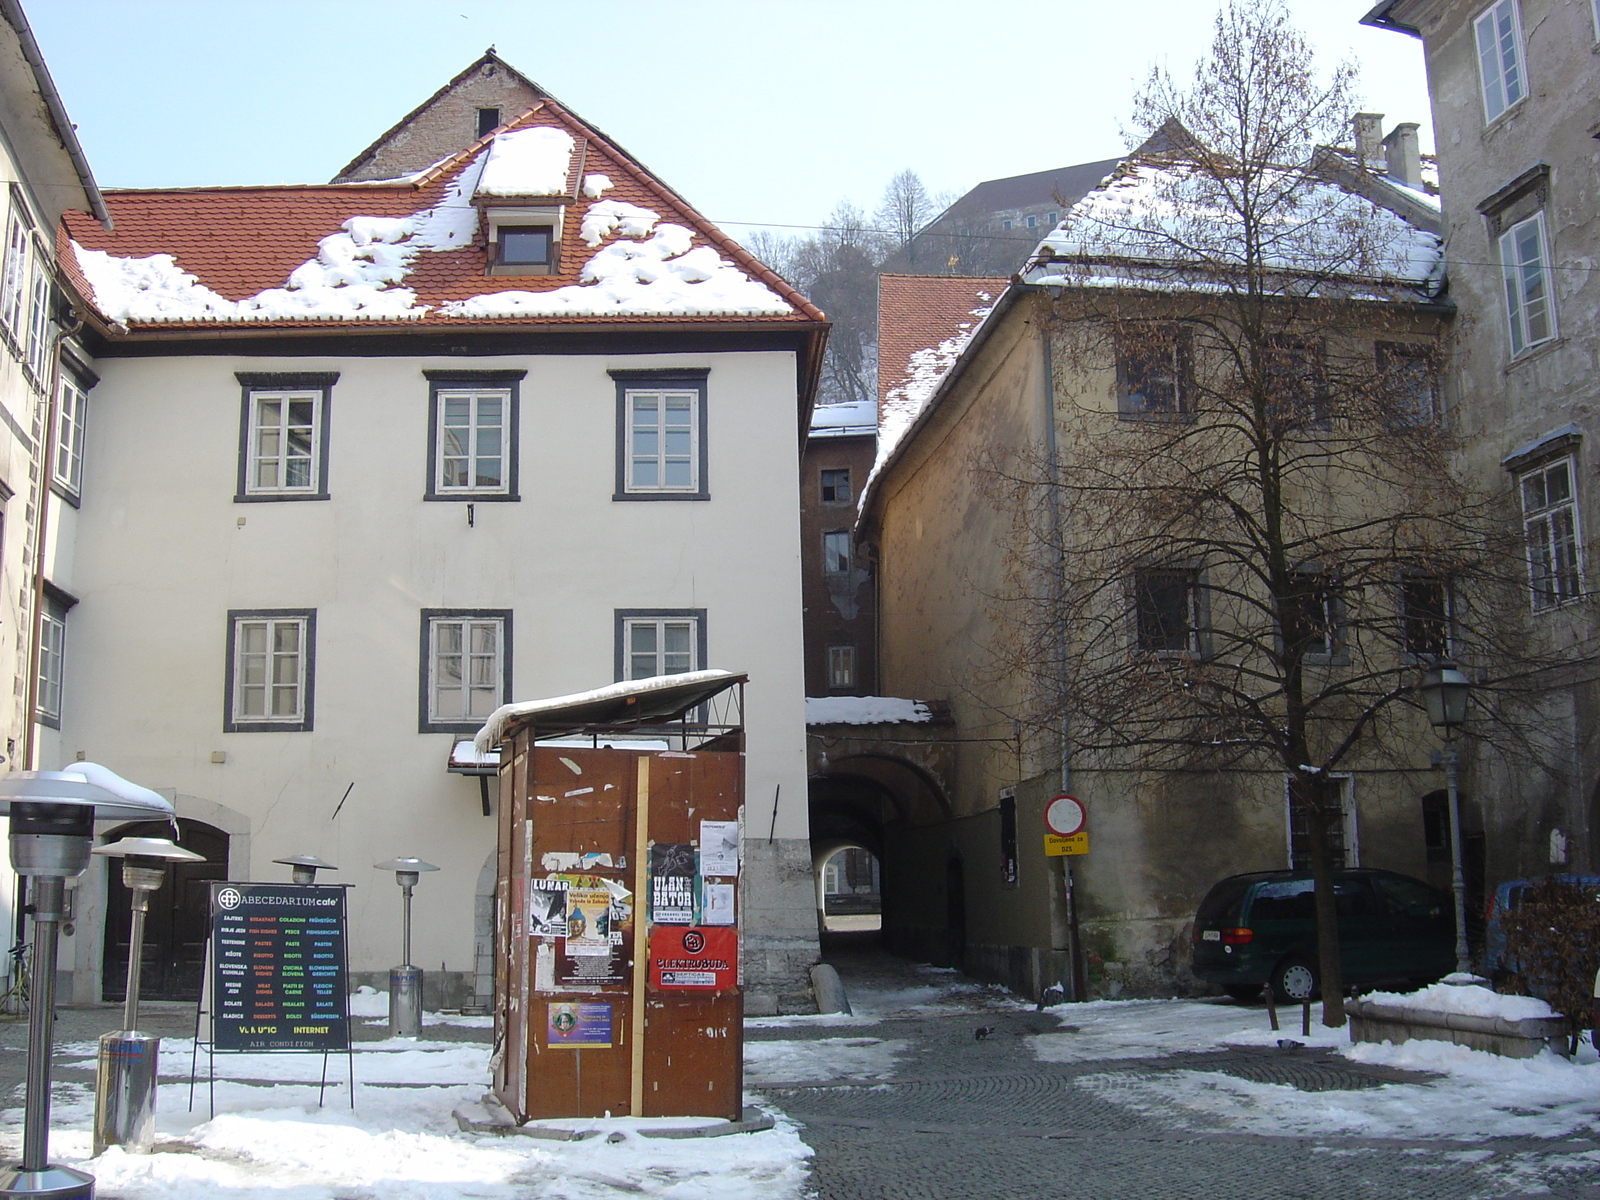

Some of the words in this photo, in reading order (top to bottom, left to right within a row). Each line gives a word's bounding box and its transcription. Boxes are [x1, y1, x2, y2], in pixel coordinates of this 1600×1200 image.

[533, 880, 569, 890] LUNAR
[654, 877, 683, 892] ULAN
[241, 896, 316, 906] ABECEDARIUM
[653, 892, 691, 906] BATOR
[293, 1026, 329, 1034] INTERNET
